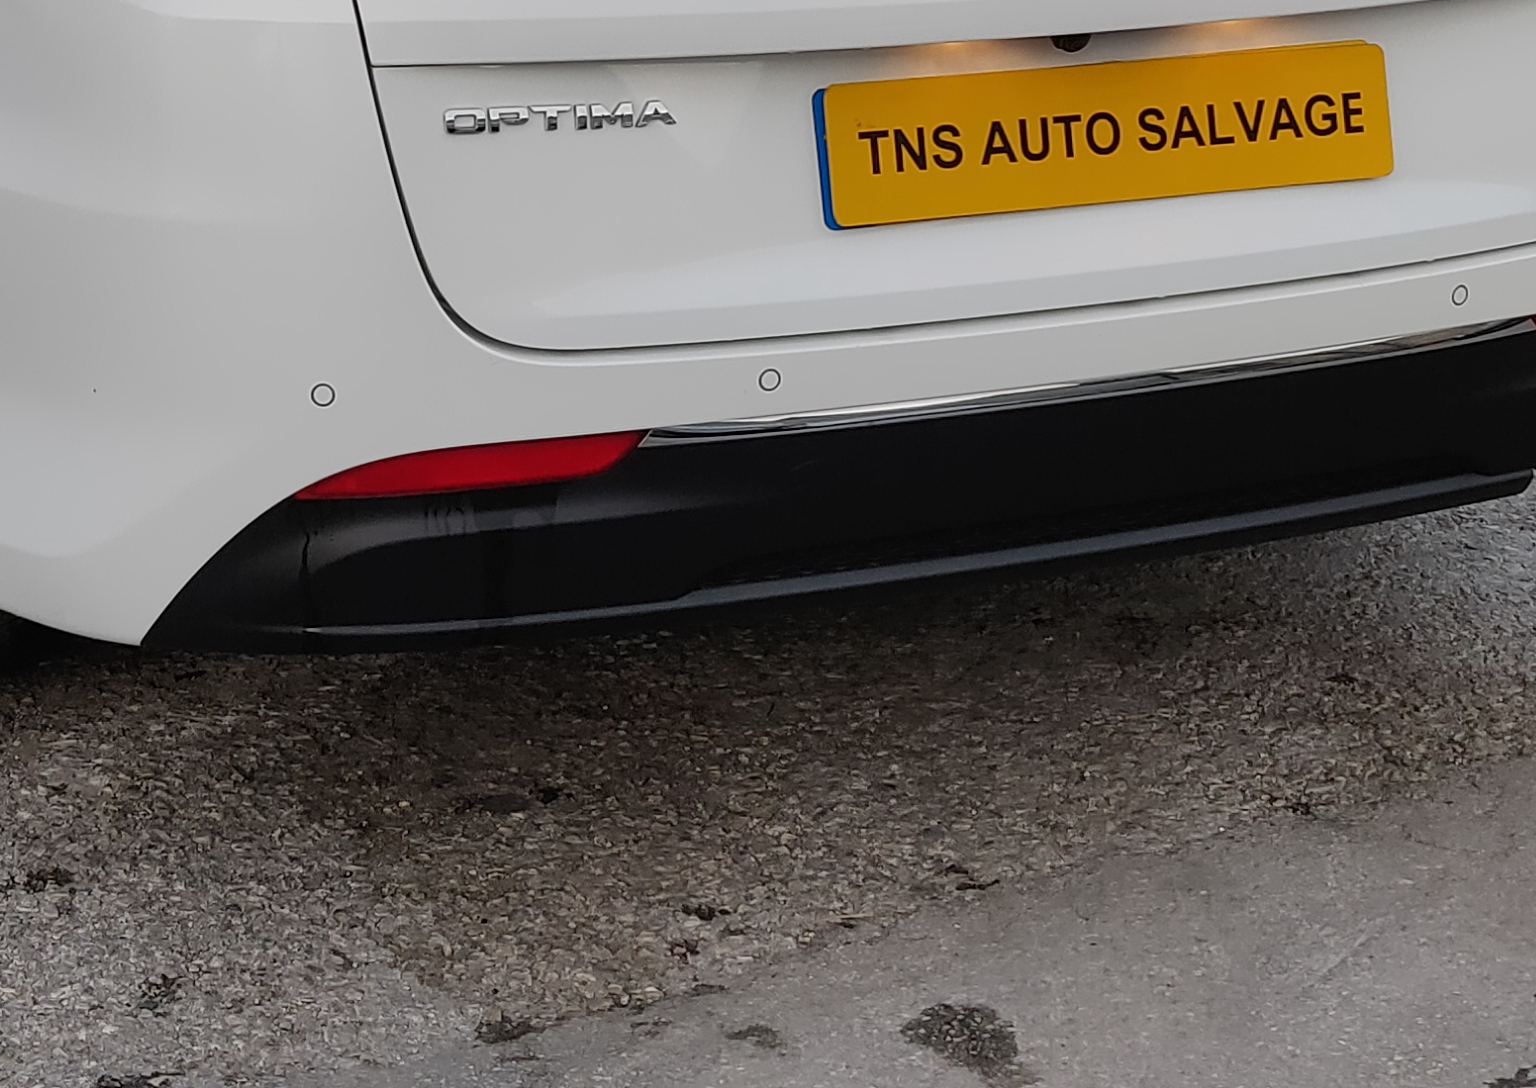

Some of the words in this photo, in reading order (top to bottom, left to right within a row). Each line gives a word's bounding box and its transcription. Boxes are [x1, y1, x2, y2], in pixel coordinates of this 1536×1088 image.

[443, 100, 677, 135] OPTIMA
[858, 124, 964, 175] TNS
[981, 111, 1122, 166] AUTO
[1138, 91, 1365, 152] SALVAGE
